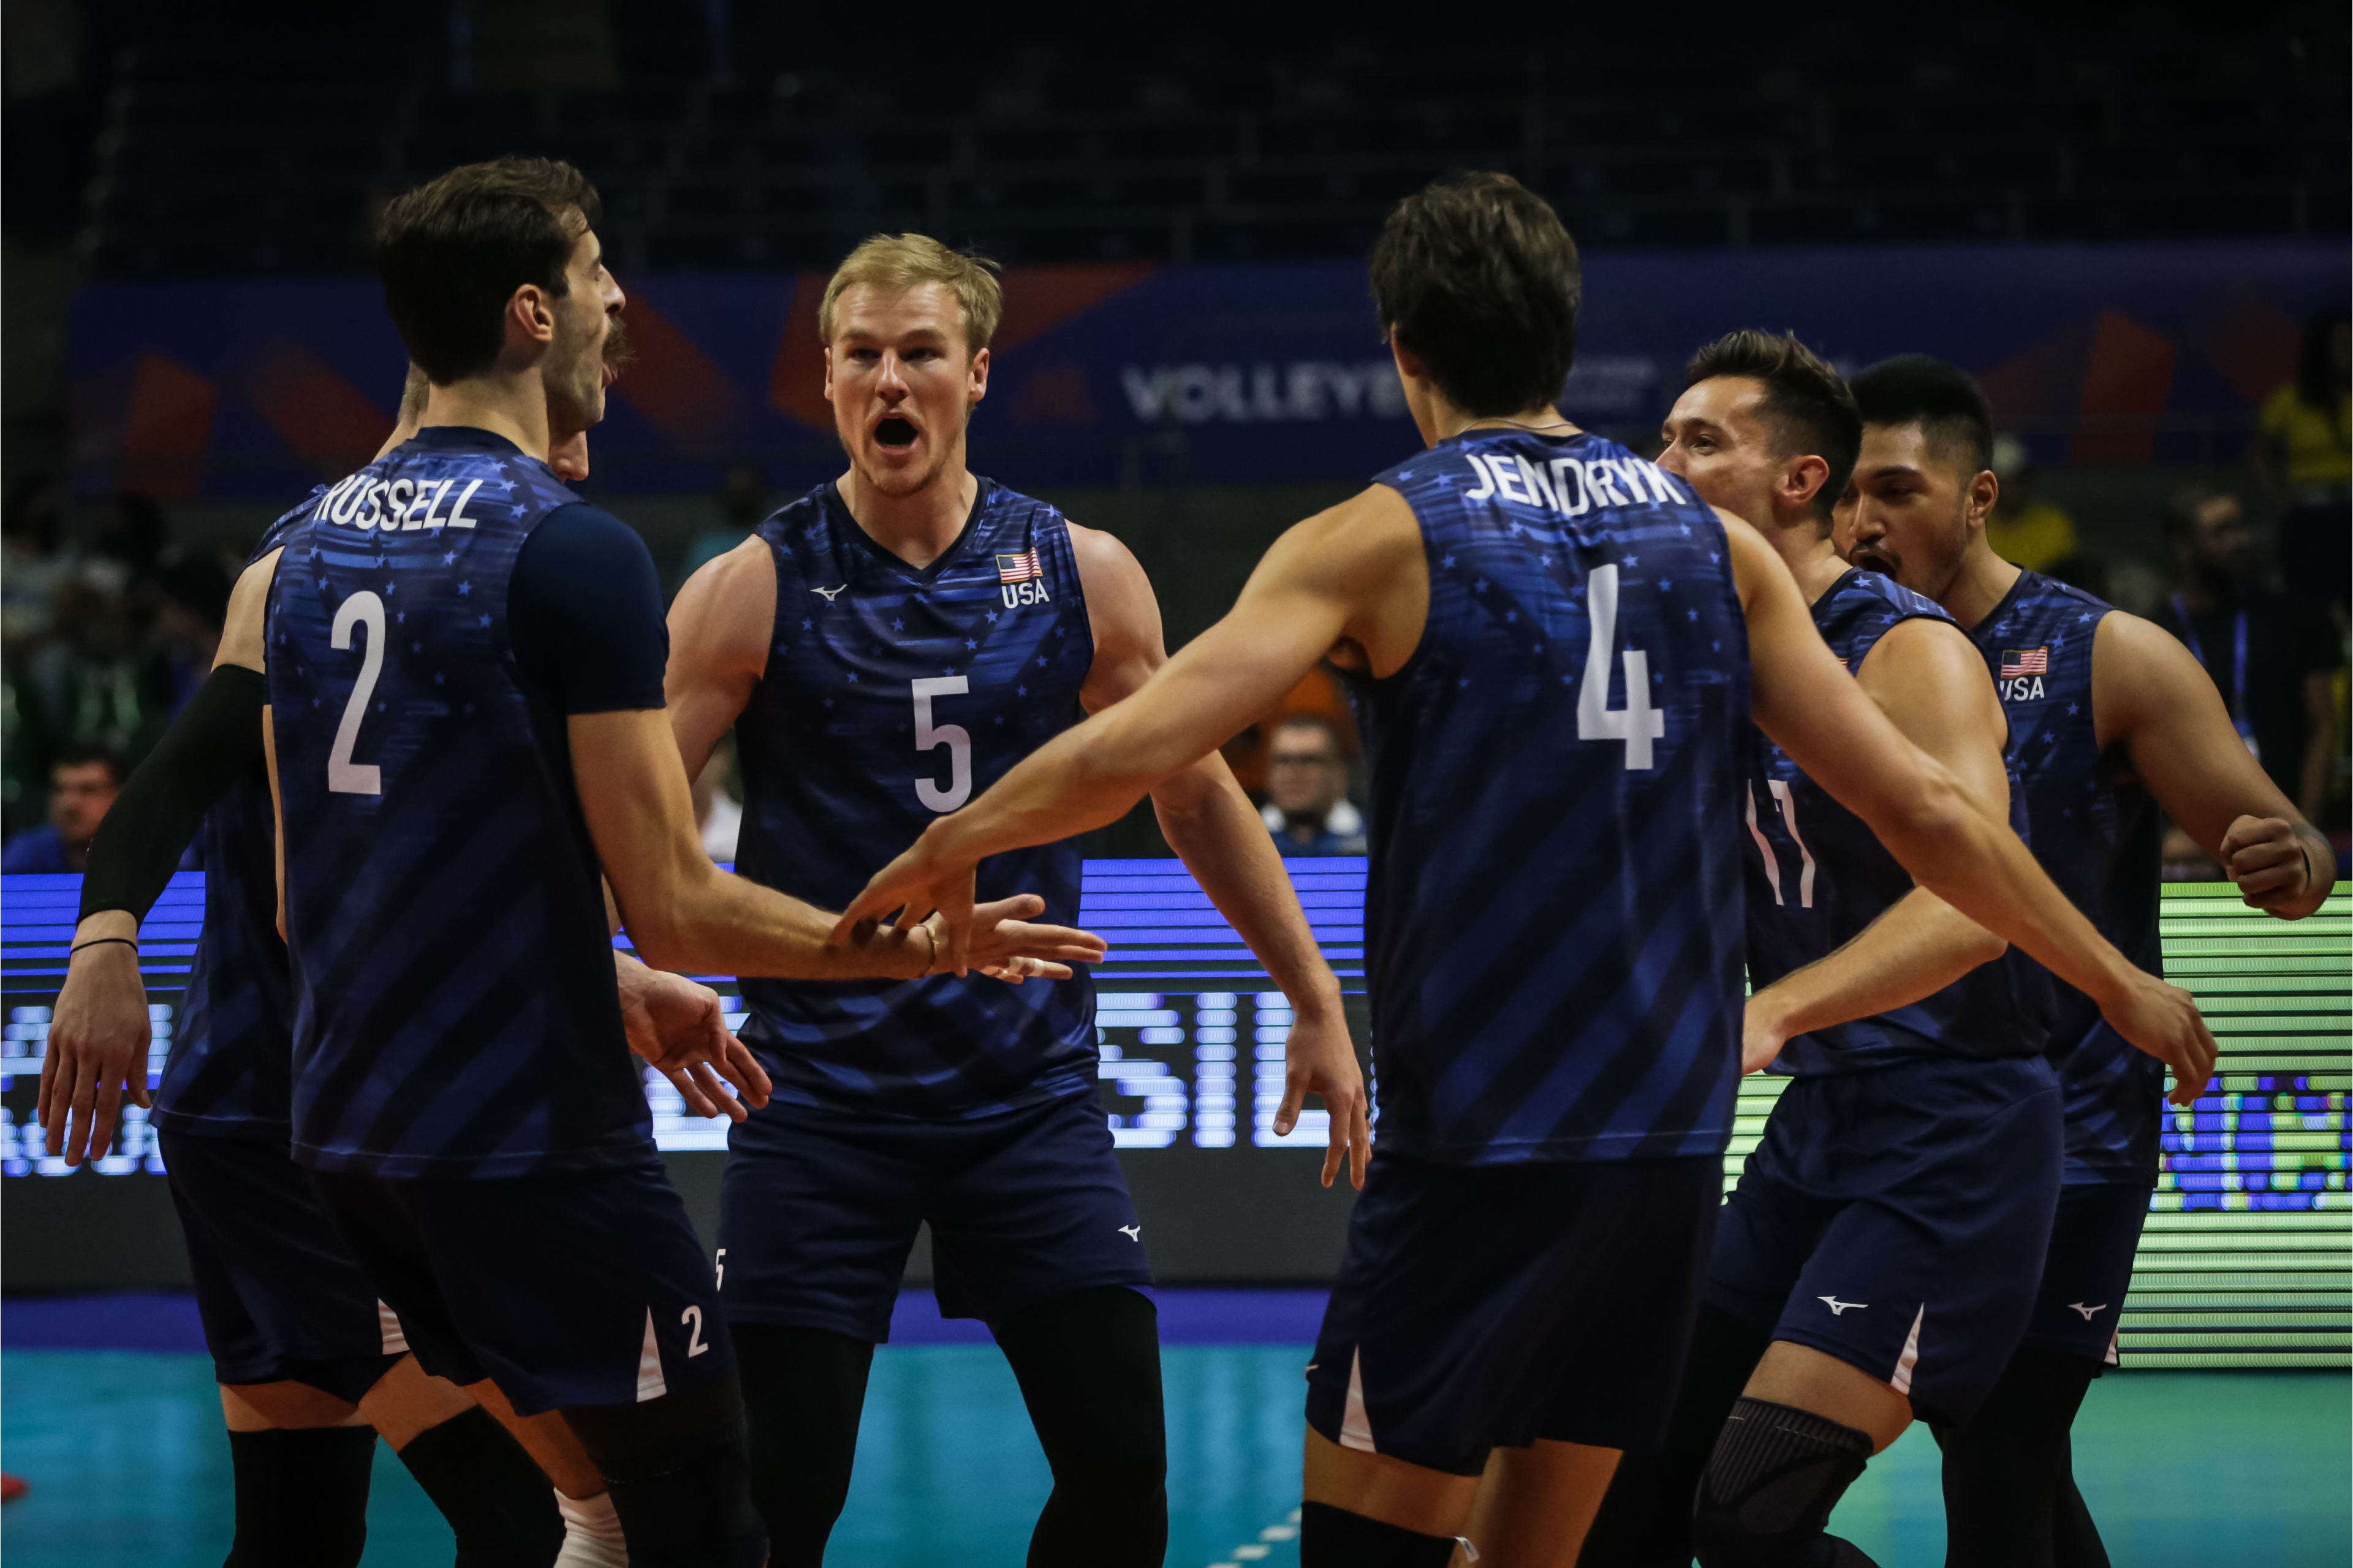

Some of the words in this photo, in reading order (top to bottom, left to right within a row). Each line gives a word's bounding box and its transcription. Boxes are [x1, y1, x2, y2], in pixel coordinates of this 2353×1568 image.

[1120, 360, 1408, 424] VOLLEYB
[313, 474, 483, 531] RUSSELL
[1001, 578, 1050, 609] USA
[328, 590, 386, 795] 2
[1577, 563, 1665, 770] 4
[911, 675, 972, 813] 5
[1745, 778, 1816, 909] 17
[681, 1305, 709, 1358] 2
